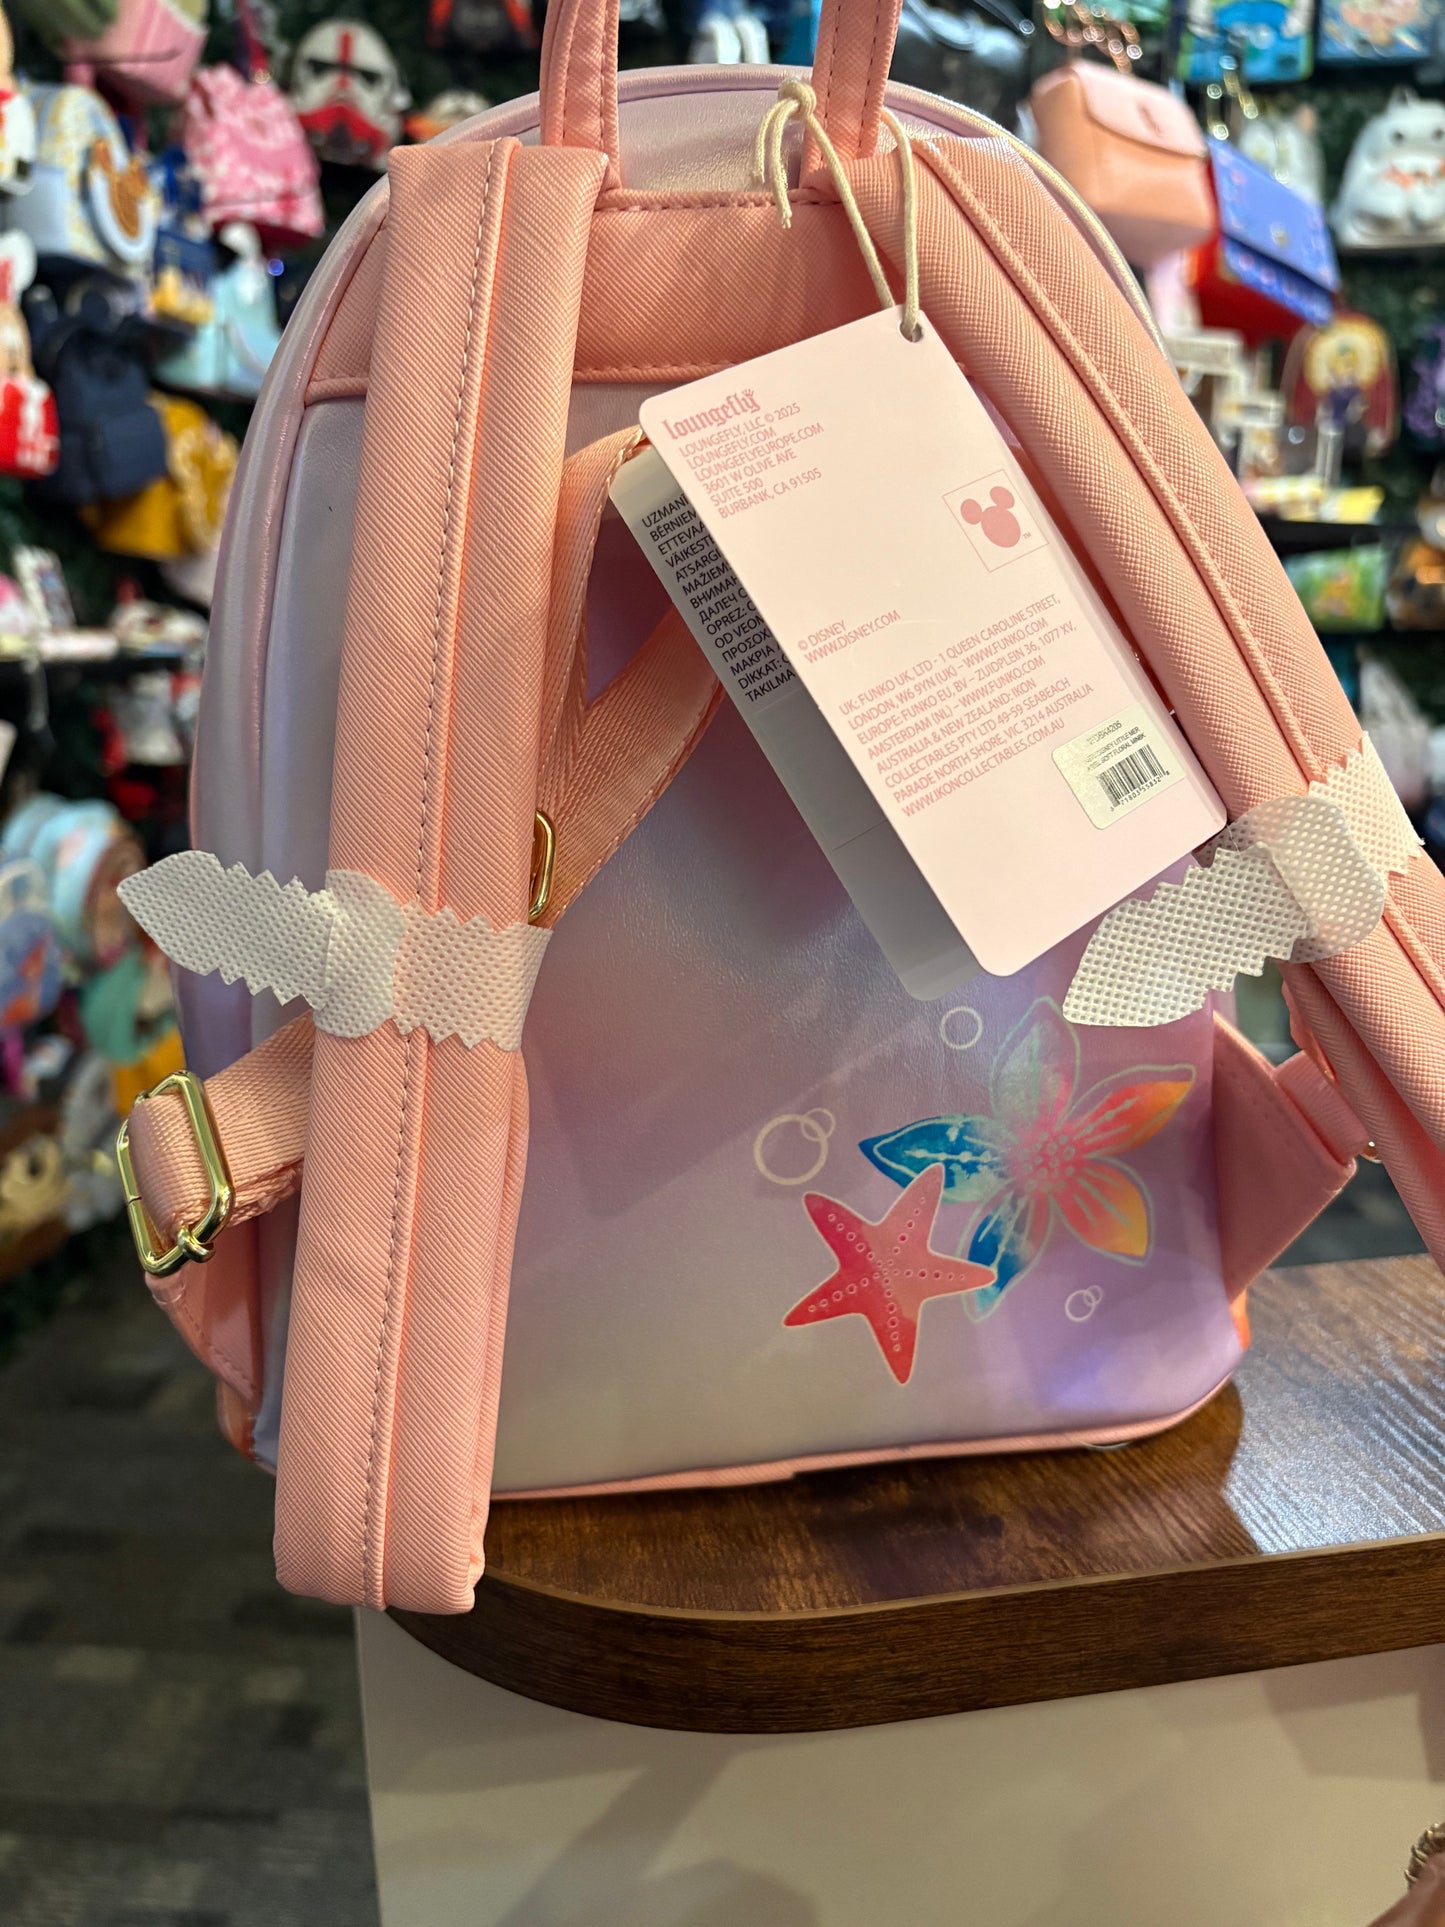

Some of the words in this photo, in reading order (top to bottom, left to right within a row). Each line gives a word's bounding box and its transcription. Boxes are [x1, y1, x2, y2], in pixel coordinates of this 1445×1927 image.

[662, 389, 761, 440] loungefly
[679, 425, 745, 458] LOUNGEFLY,
[745, 416, 766, 432] LLC
[774, 402, 801, 421] 2025
[686, 427, 777, 470] LOUNGEFLY.COM
[694, 423, 824, 482] LOUNGEFLYEUROPE.COM
[702, 476, 730, 494] 3601
[729, 470, 743, 482] W
[744, 456, 776, 477] OLIVE
[777, 448, 797, 465] AVE
[710, 486, 743, 507] SUITE
[744, 477, 764, 494] 500
[718, 489, 775, 519] BURBANK,
[773, 481, 790, 496] CA
[789, 468, 822, 489] 91505
[699, 594, 737, 625] ДАЛЕЧ
[706, 607, 748, 635] OPREZ:
[804, 609, 901, 664] WWW.DISNEY.COM
[807, 620, 847, 647] DISNEY
[714, 632, 734, 649] OD
[839, 700, 861, 716] UK:
[857, 679, 896, 705] FUNKO
[894, 670, 915, 686] UK,
[912, 660, 933, 677] LTD
[946, 634, 982, 659] QUEEN
[980, 609, 1027, 641] CAROLINE
[1025, 593, 1061, 618] STREET,
[745, 669, 796, 702] TAKILMA
[848, 700, 899, 731] LONDON,
[895, 688, 916, 702] W6
[914, 675, 937, 695] 9YN
[934, 665, 958, 685] (UK)
[963, 617, 1049, 669] WWW.FUNKO.COM
[856, 714, 903, 745] EUROPE:
[900, 695, 937, 722] FUNKO
[936, 686, 956, 702] EU,
[953, 678, 968, 692] BV
[974, 647, 1025, 682] ZUIDPLEIN
[1024, 641, 1041, 655] 36,
[1038, 628, 1061, 646] 1077
[1061, 620, 1077, 636] XV,
[867, 716, 933, 760] AMSTERDAM
[931, 705, 953, 725] (NL)
[958, 655, 1046, 709] WWW.FUNKO.COM
[877, 737, 934, 775] AUSTRALIA
[931, 731, 942, 743] &
[940, 717, 965, 738] NEW
[964, 692, 1014, 725] ZEALAND:
[1010, 677, 1037, 698] IKON
[884, 740, 959, 789] COLLECTABLES
[957, 728, 978, 747] PTY
[977, 719, 997, 737] LTD
[997, 704, 1024, 725] 49-59
[1023, 677, 1071, 711] SEABEACH
[893, 772, 937, 804] PARADE
[934, 752, 972, 780] NORTH
[969, 732, 1007, 760] SHORE,
[1003, 724, 1023, 739] VIC
[1021, 710, 1045, 731] 3214
[1044, 683, 1094, 717] AUSTRALIA
[901, 717, 1065, 818] WWW.IKONCOLLECTABLES.COM.AU
